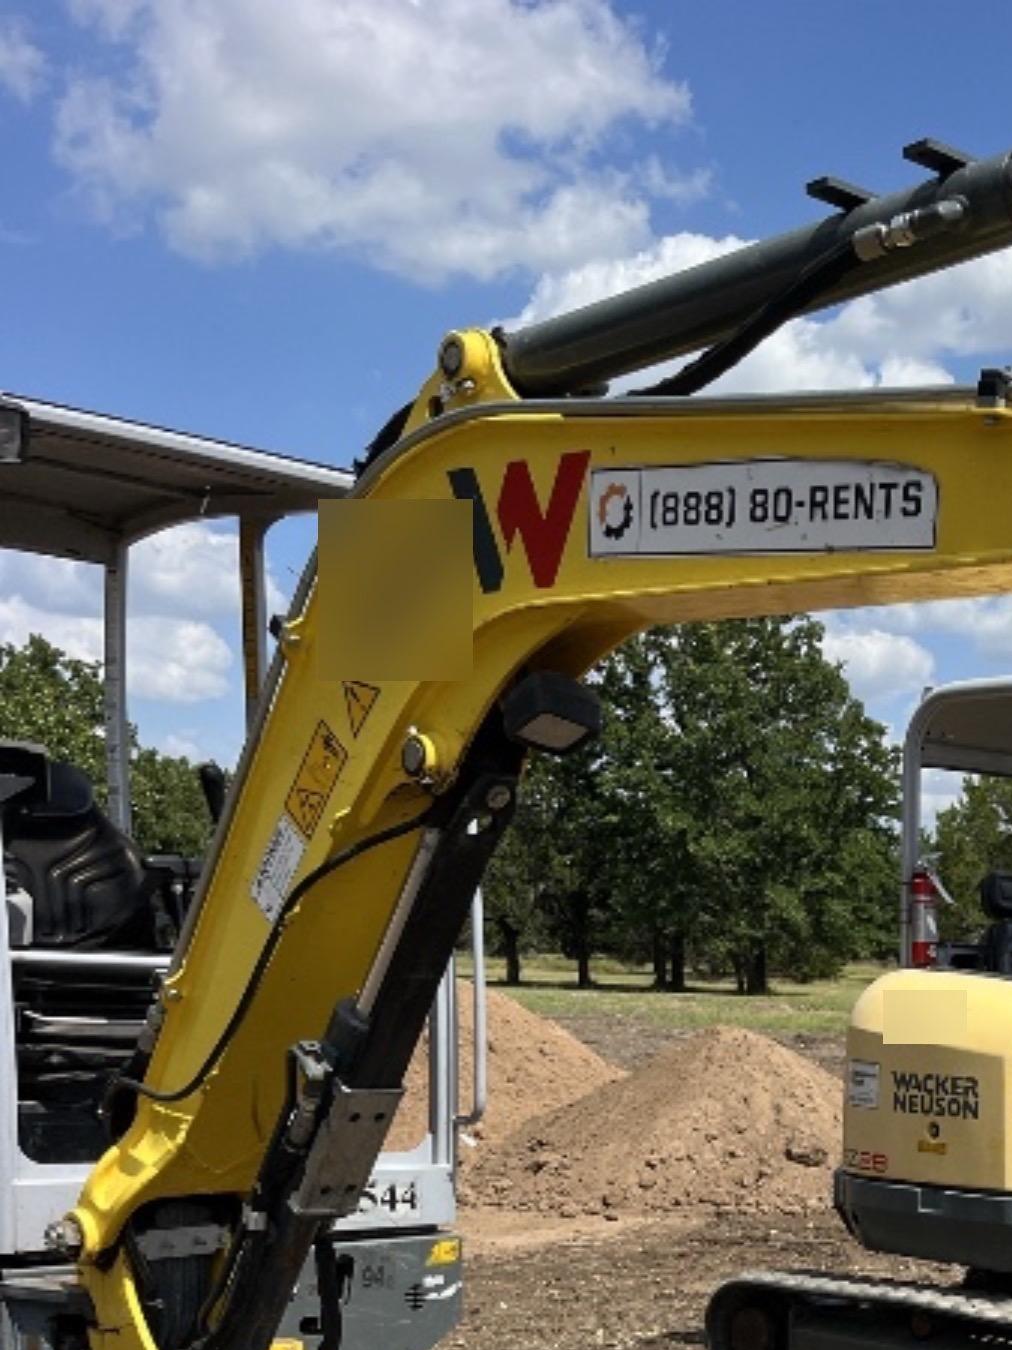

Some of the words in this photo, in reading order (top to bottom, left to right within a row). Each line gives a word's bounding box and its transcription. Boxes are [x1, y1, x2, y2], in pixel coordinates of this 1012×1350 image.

[651, 485, 736, 530] (888)
[750, 479, 923, 523] 80-RENTS
[891, 1070, 979, 1098] WACKER
[893, 1092, 979, 1120] NEUSON
